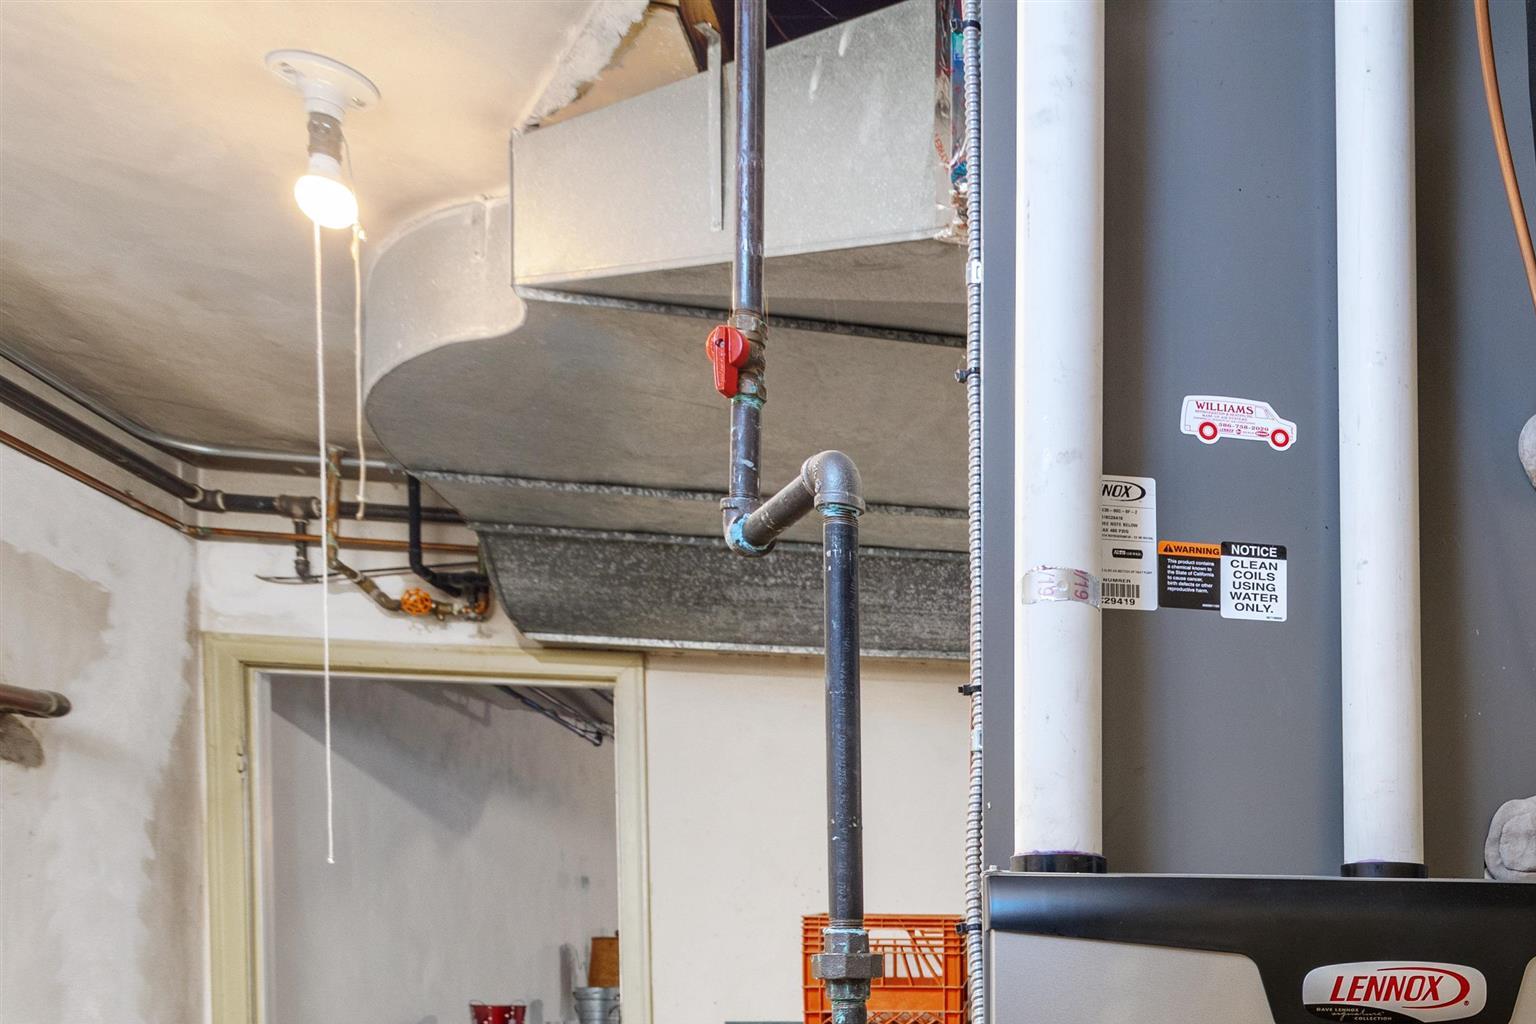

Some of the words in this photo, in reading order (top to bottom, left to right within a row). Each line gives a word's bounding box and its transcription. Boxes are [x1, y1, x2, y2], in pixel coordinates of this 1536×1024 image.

[1196, 401, 1254, 415] WILLIAMS
[1174, 546, 1220, 556] WARNING
[1232, 544, 1278, 557] NOTICE
[1230, 560, 1278, 571] CLEAN
[1233, 570, 1276, 582] COILS
[1232, 581, 1276, 592] USING
[1230, 592, 1278, 602] WATER
[1234, 602, 1274, 614] ONLY.
[1330, 976, 1444, 1002] LENNOX
